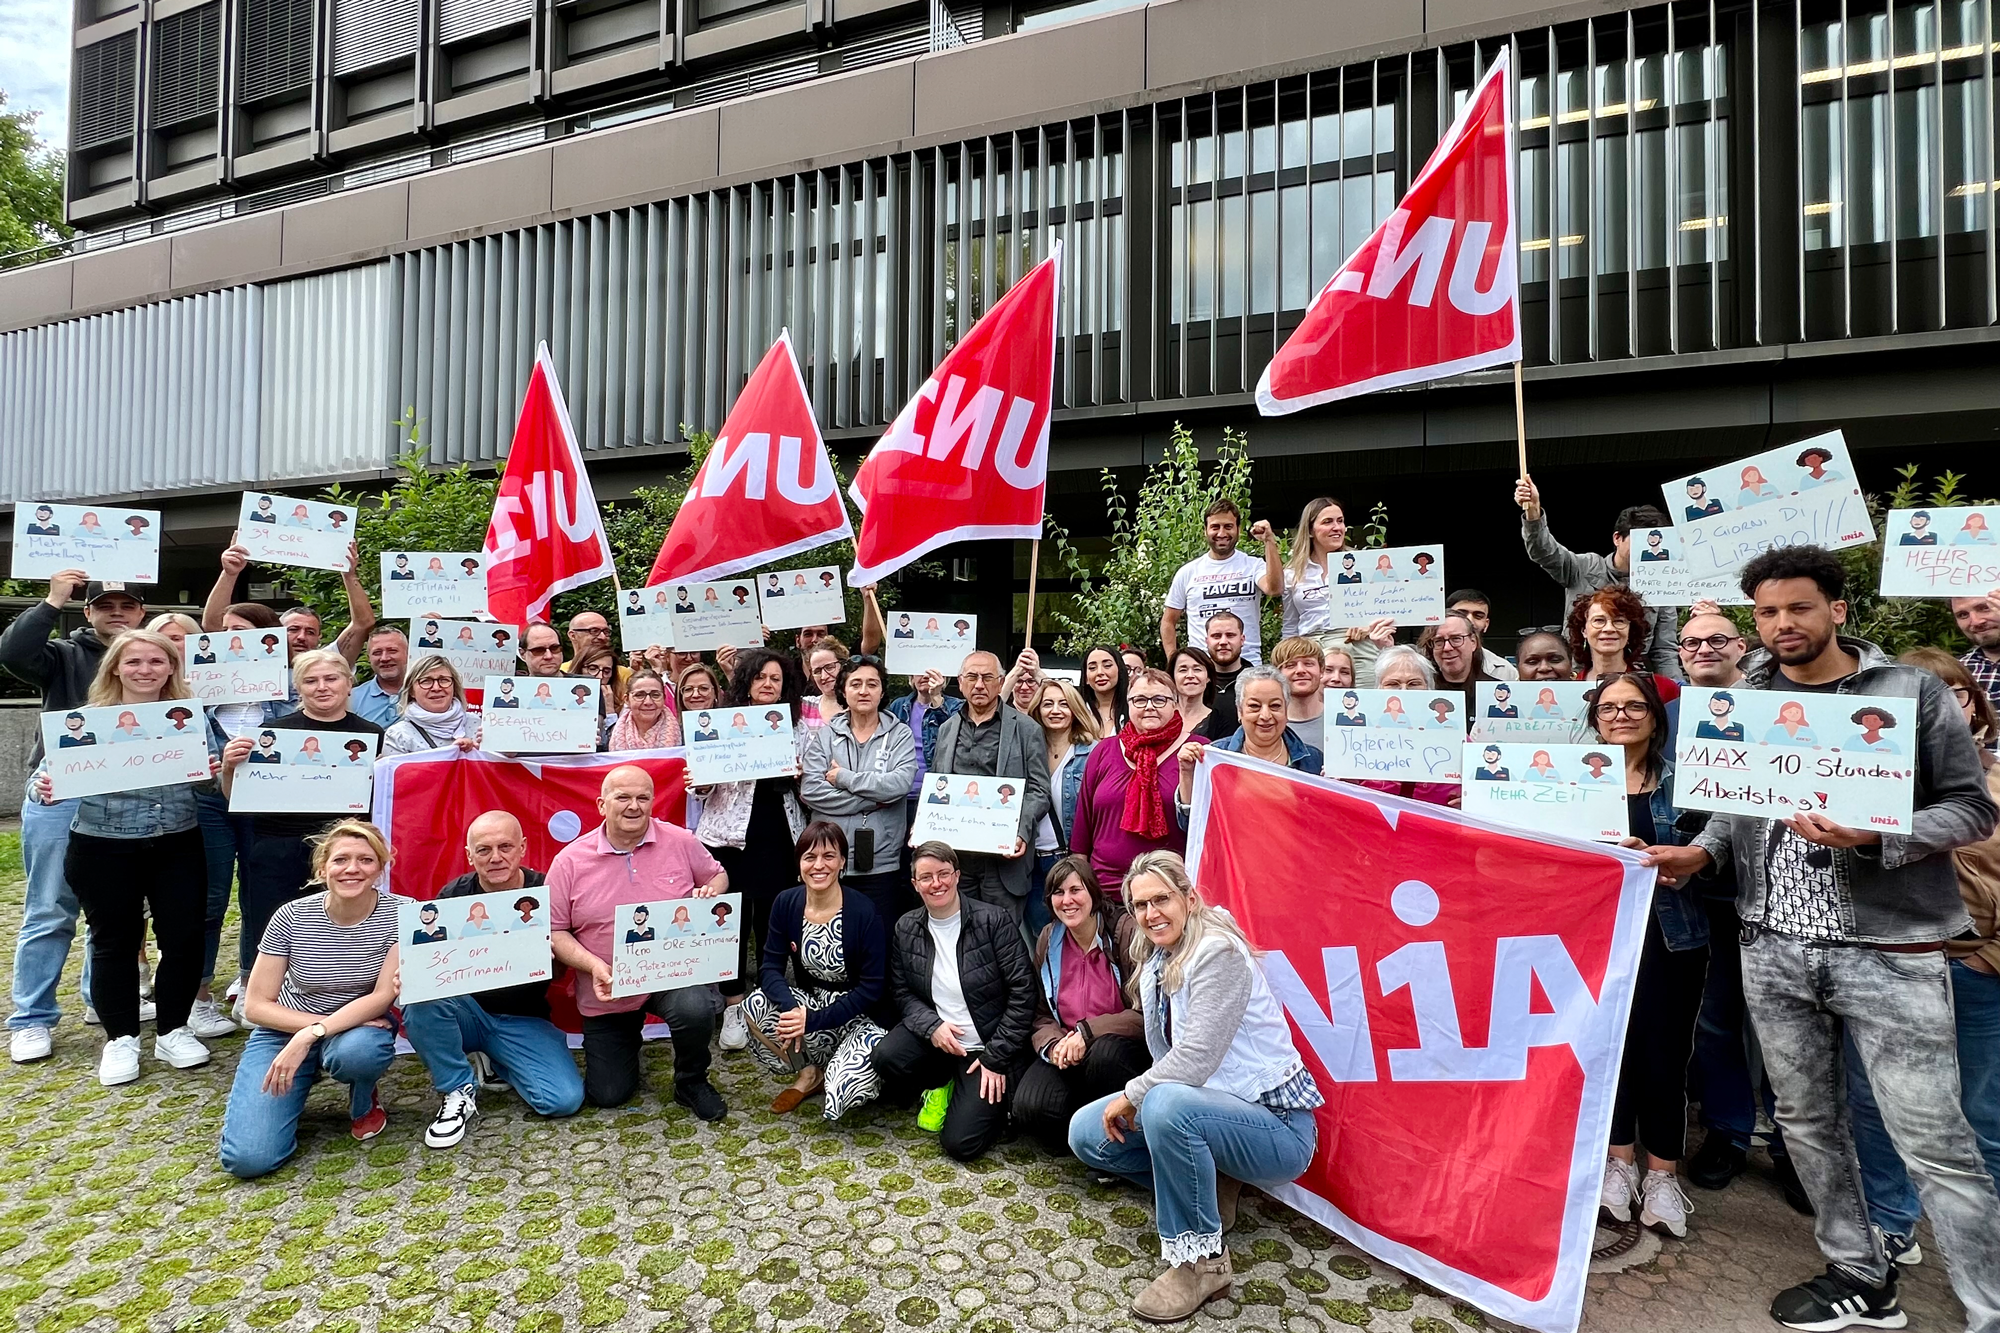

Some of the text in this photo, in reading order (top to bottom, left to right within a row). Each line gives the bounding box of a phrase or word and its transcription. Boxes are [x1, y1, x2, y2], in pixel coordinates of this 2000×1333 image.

[278, 534, 304, 543] ORE
[1692, 529, 1707, 546] 2
[1906, 550, 1968, 567] MEHR
[1916, 565, 2000, 586] PERS
[400, 583, 457, 592] SETTIMANA
[407, 596, 443, 605] CORTA
[486, 713, 545, 727] BEZAHLTE
[520, 727, 568, 742] PAUSEN
[64, 749, 185, 775] MAX 10 ORE
[1683, 745, 1748, 768] MAX
[249, 770, 288, 781] Mehr
[1490, 786, 1529, 800] MEHR
[663, 939, 685, 951] ORE
